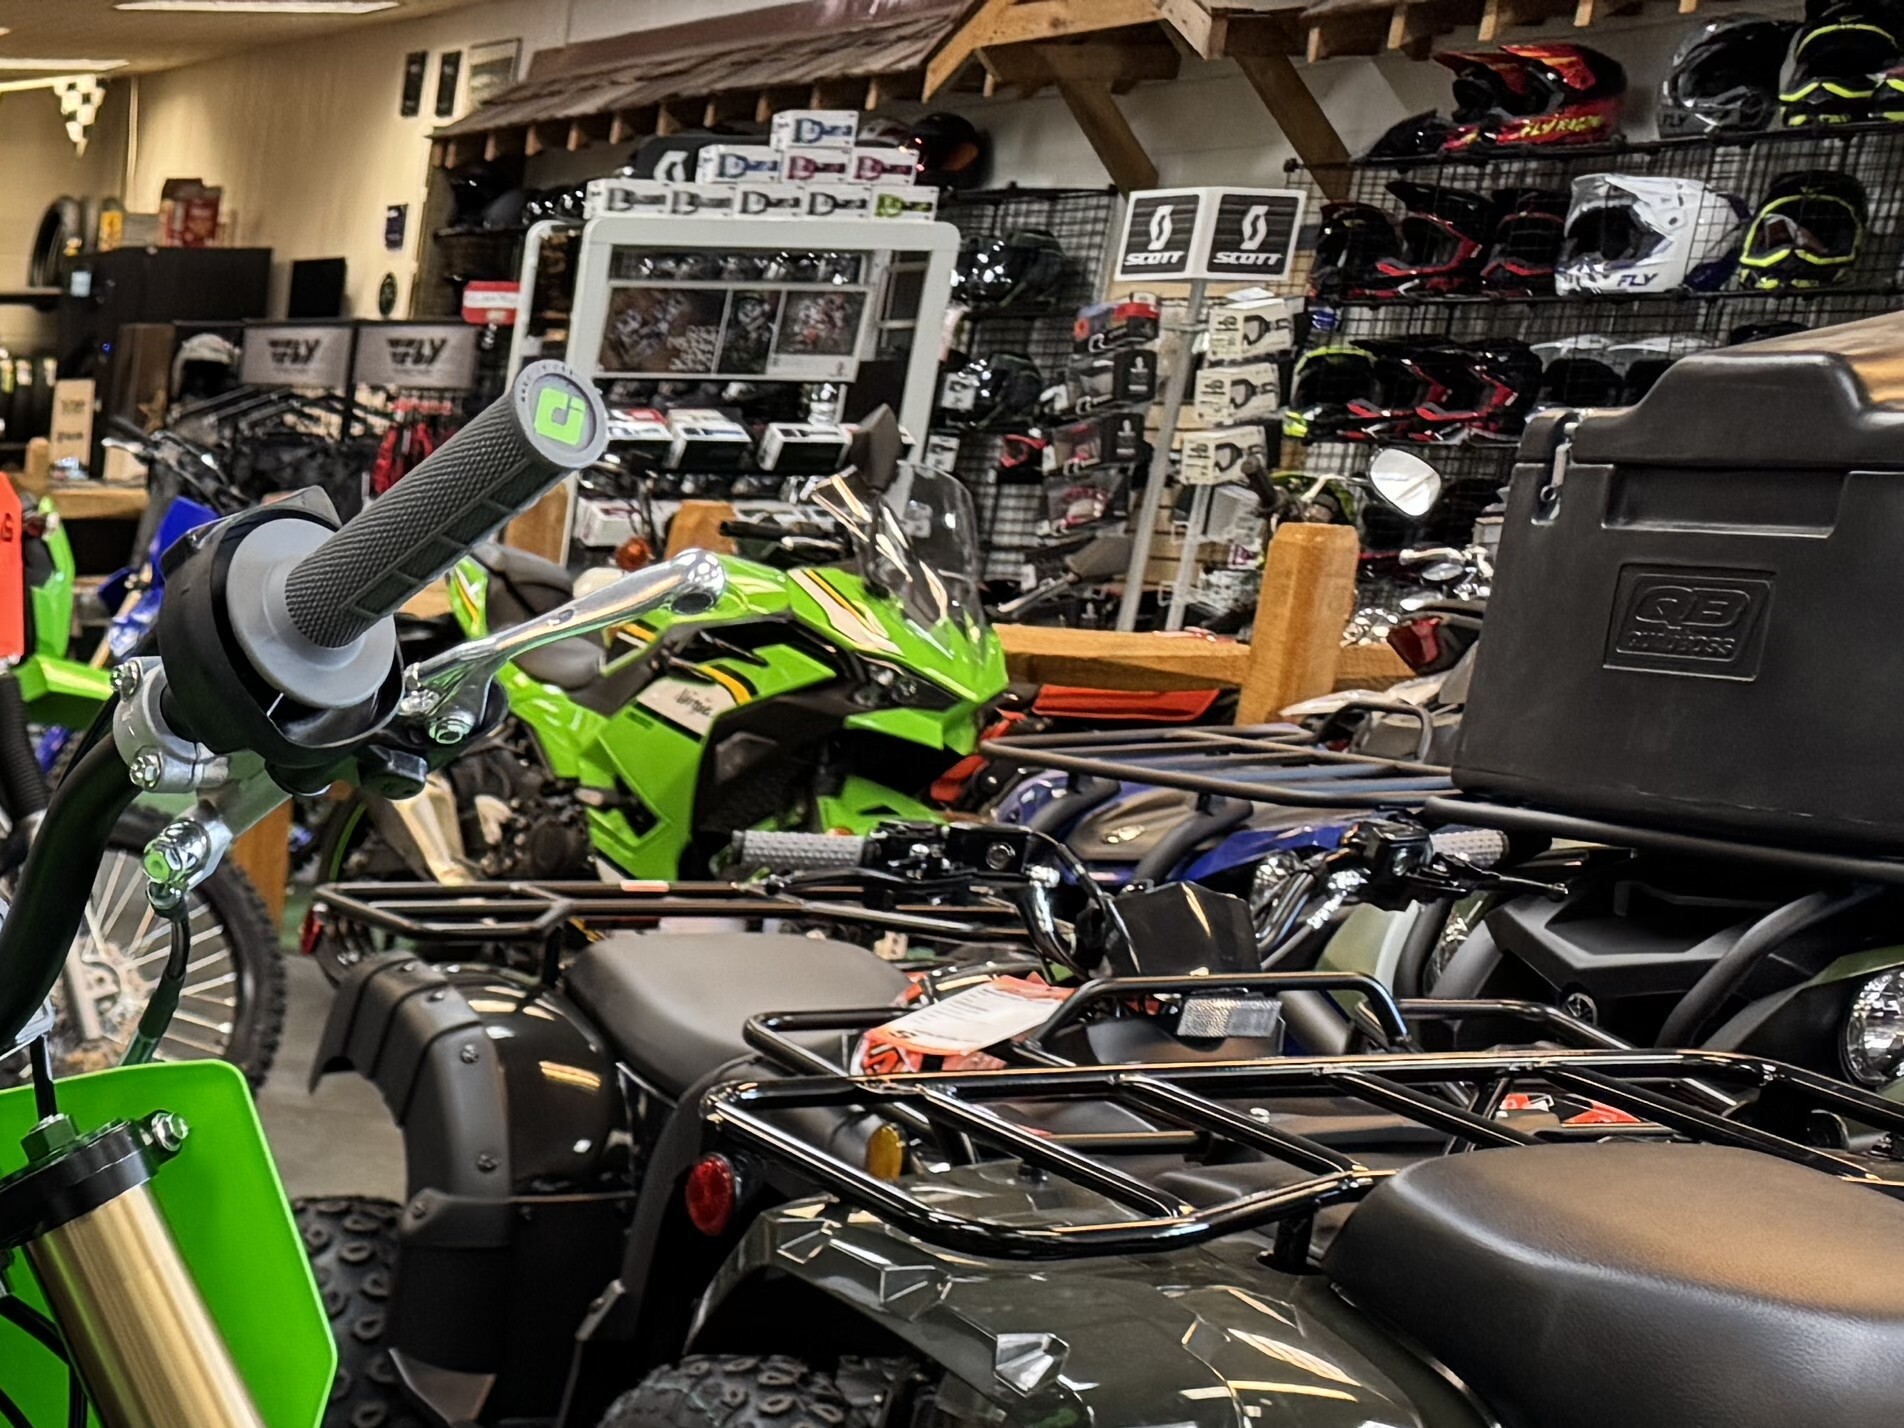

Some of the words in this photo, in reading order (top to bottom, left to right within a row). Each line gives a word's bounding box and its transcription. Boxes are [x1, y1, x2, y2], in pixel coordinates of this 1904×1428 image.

[1124, 250, 1186, 266] SCOTT
[1212, 250, 1283, 266] SCOTT
[1616, 272, 1659, 287] FLY
